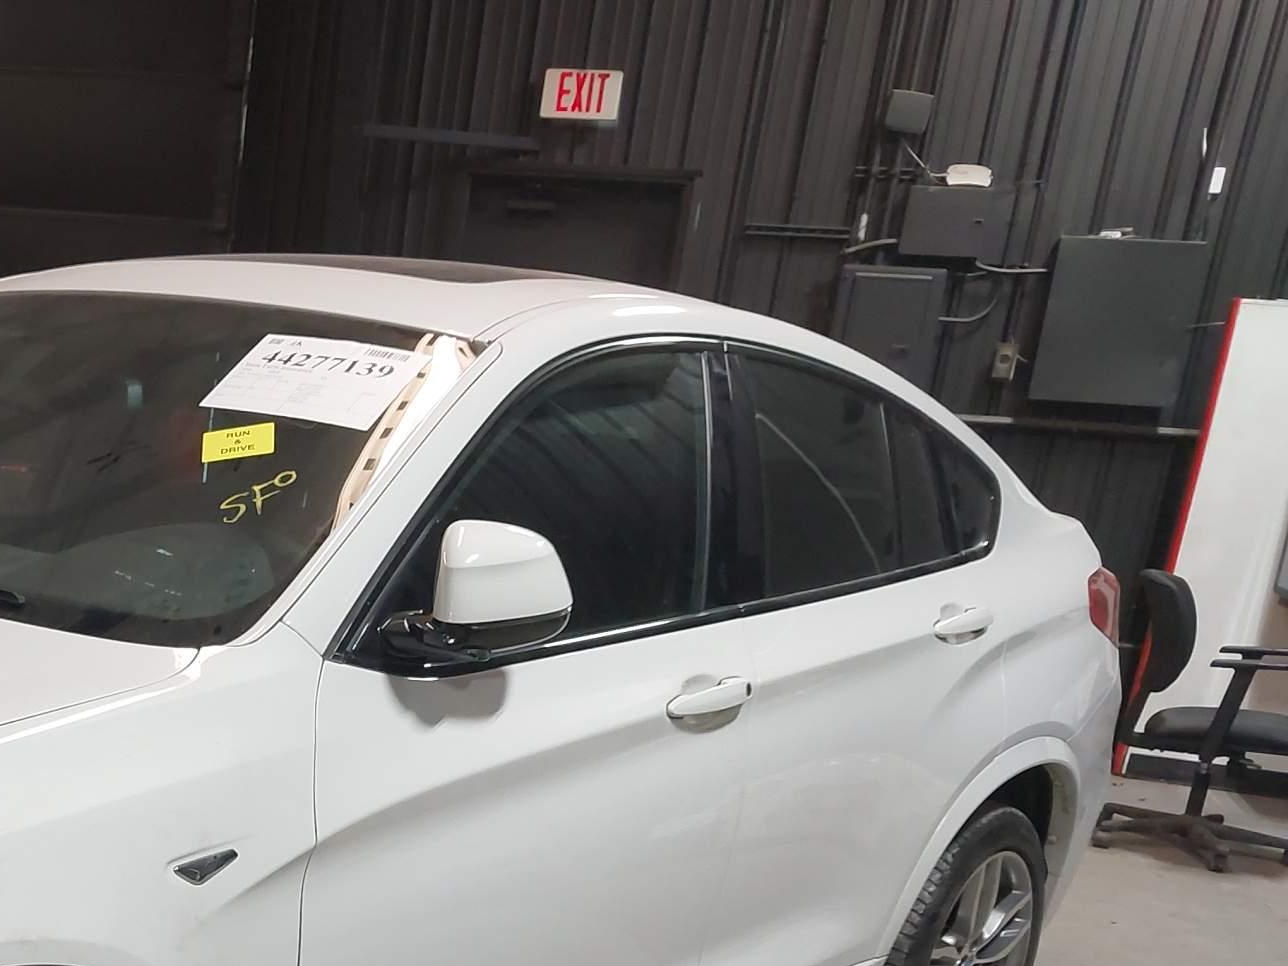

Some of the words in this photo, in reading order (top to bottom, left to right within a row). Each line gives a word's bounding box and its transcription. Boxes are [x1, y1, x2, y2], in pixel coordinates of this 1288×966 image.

[556, 72, 610, 113] EXIT
[263, 351, 395, 378] 44277139
[226, 430, 251, 439] RUN
[220, 444, 255, 454] DRIVE
